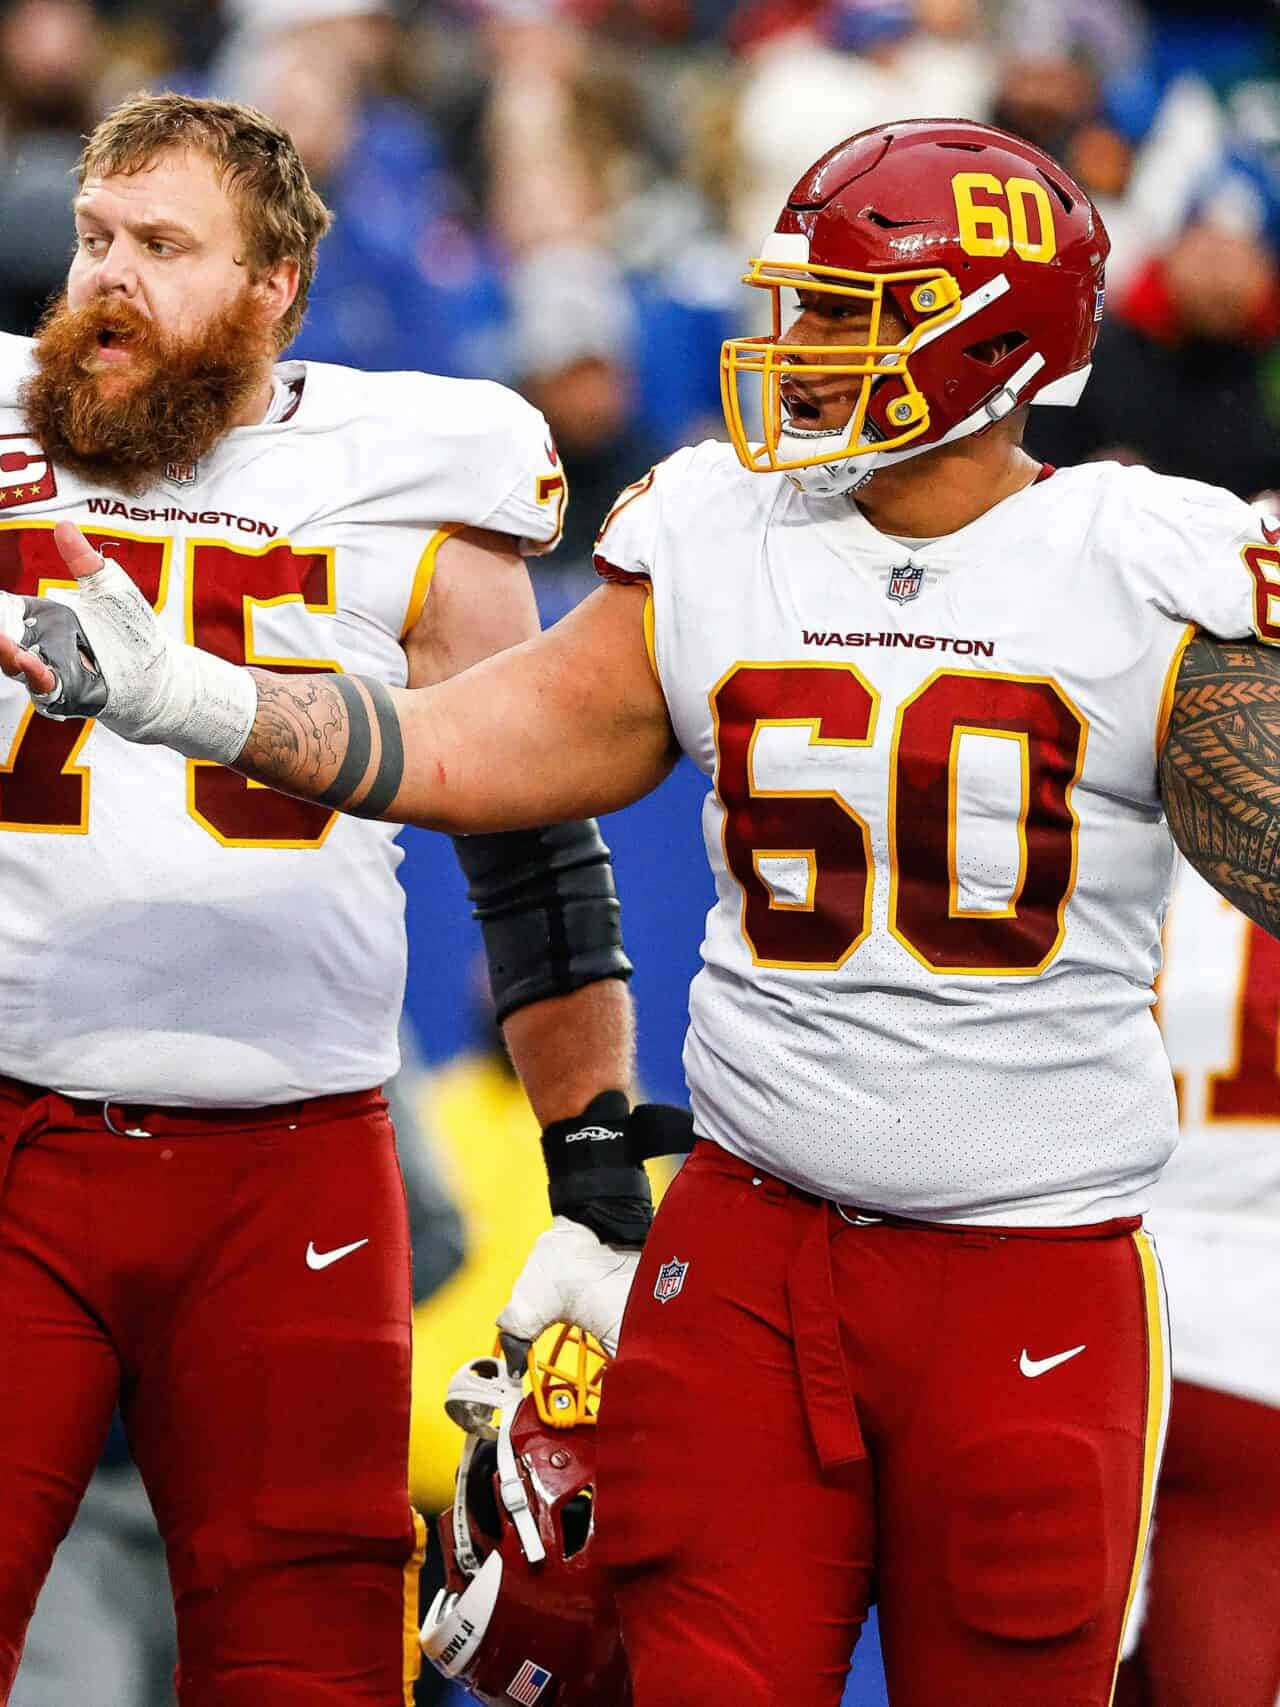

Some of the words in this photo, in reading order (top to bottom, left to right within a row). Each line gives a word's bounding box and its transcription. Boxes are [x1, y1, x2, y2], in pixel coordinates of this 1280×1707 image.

[951, 172, 1057, 264] 60
[86, 497, 279, 539] WASHINGTON
[891, 579, 918, 596] NFL
[801, 630, 995, 657] WASHINGTON
[707, 659, 1091, 977] 60
[657, 1277, 680, 1295] NFL
[461, 1619, 475, 1637] IT
